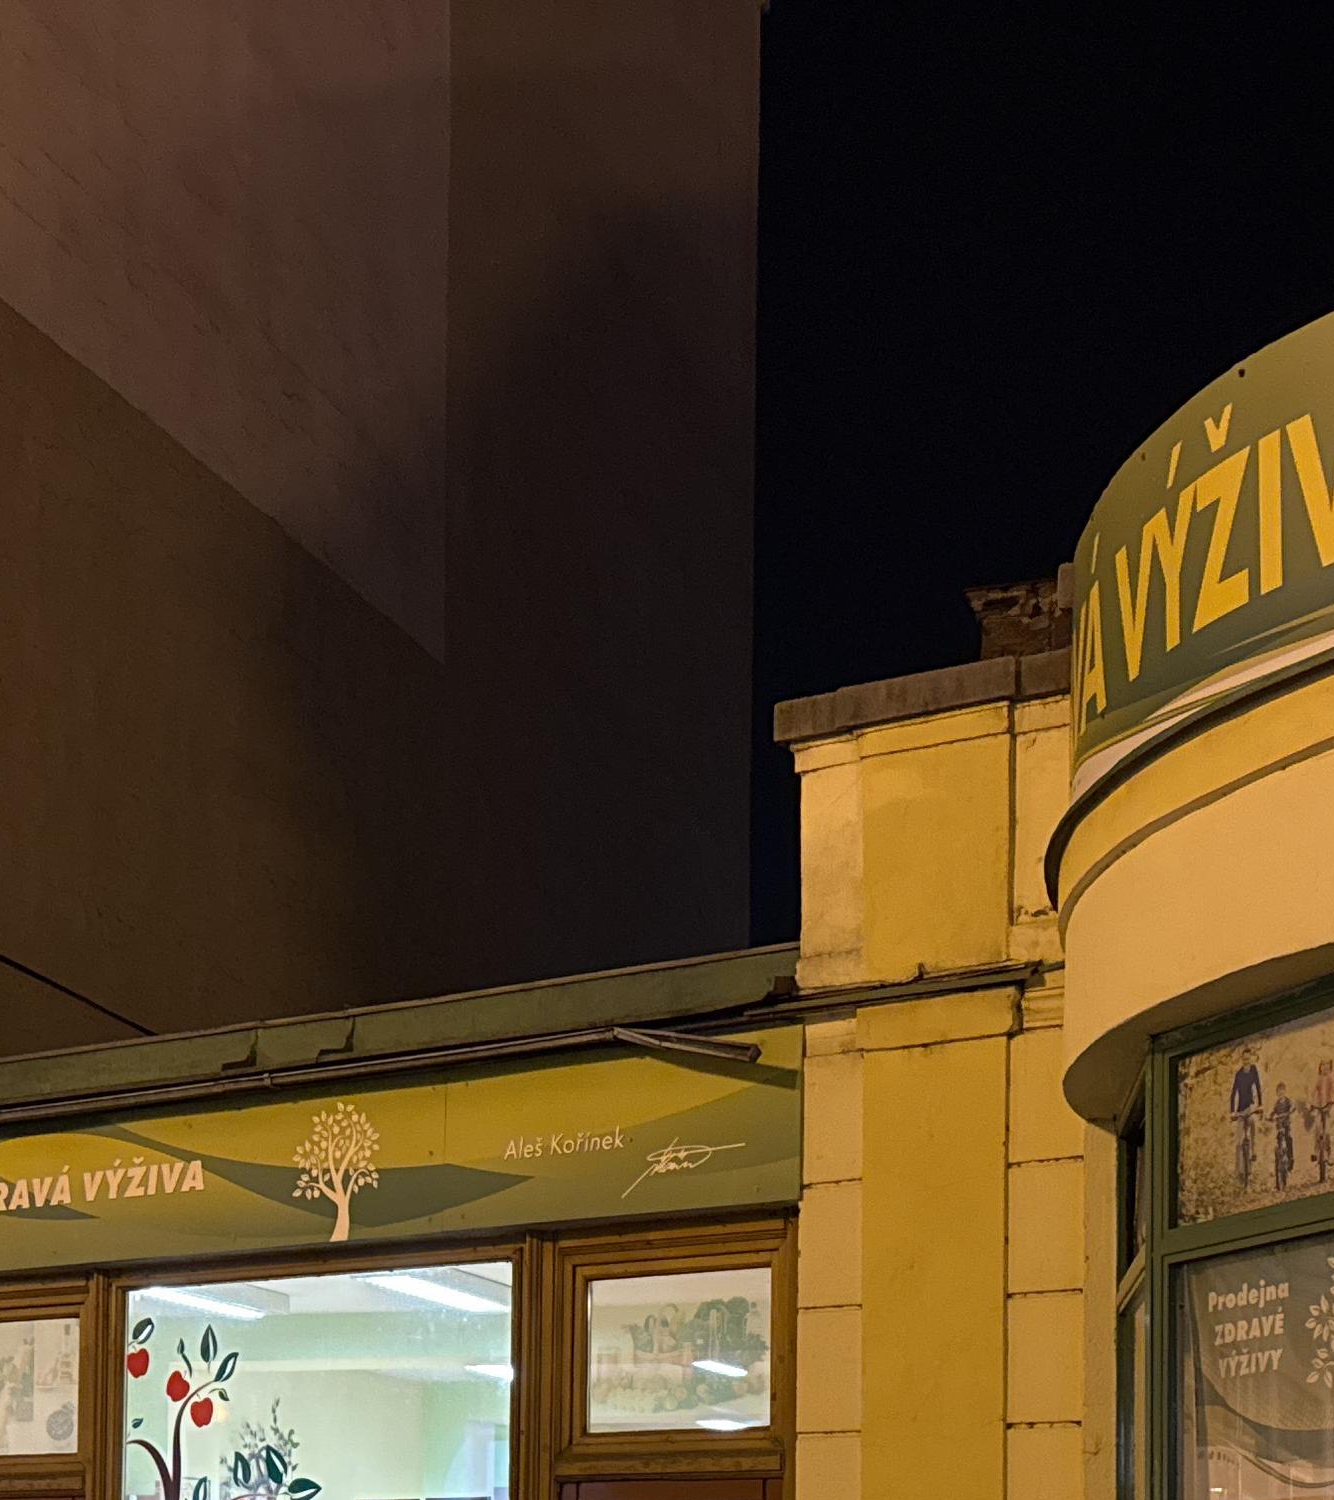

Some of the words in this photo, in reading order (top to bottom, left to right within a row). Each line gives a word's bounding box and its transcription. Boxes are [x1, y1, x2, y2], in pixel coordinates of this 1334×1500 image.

[504, 1136, 543, 1160] Aleš
[550, 1125, 625, 1156] Kořínek
[83, 1156, 205, 1202] VÝŽIVA
[1208, 1279, 1289, 1312] Prodejna
[1214, 1306, 1285, 1346] ZDRAVÉ
[1219, 1348, 1283, 1379] VÝŽIVY
